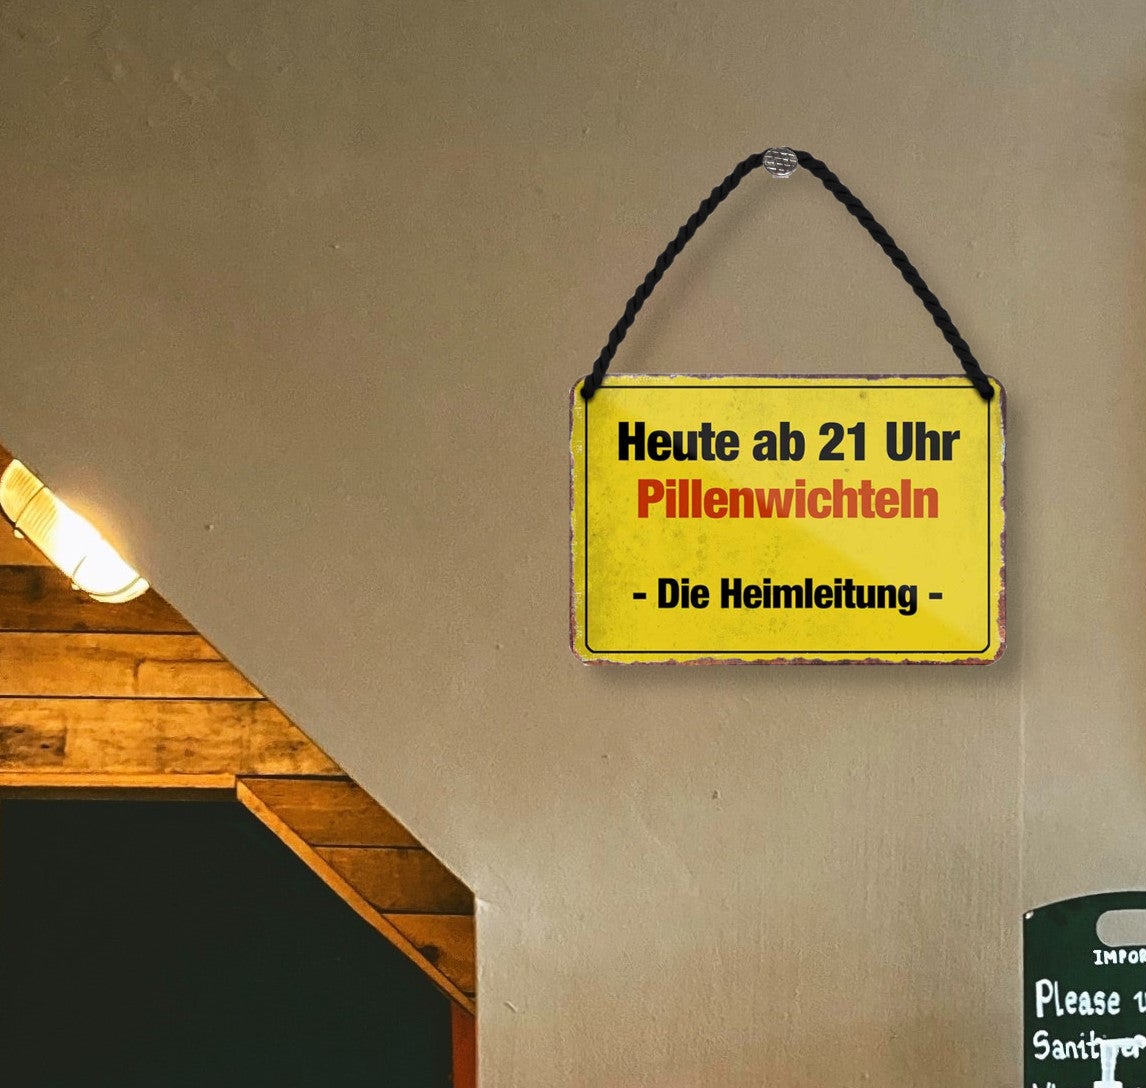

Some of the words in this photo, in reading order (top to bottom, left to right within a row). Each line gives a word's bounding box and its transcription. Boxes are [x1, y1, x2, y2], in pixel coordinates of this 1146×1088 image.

[618, 421, 740, 462] Heute
[752, 421, 806, 462] ab
[818, 421, 867, 461] 21
[886, 421, 961, 462] Uhr
[637, 478, 939, 519] Pillenwichteln
[657, 577, 710, 609] Die
[720, 577, 918, 616] Heimleitung
[1035, 978, 1121, 1018] Please
[1032, 1030, 1145, 1061] Saniter
